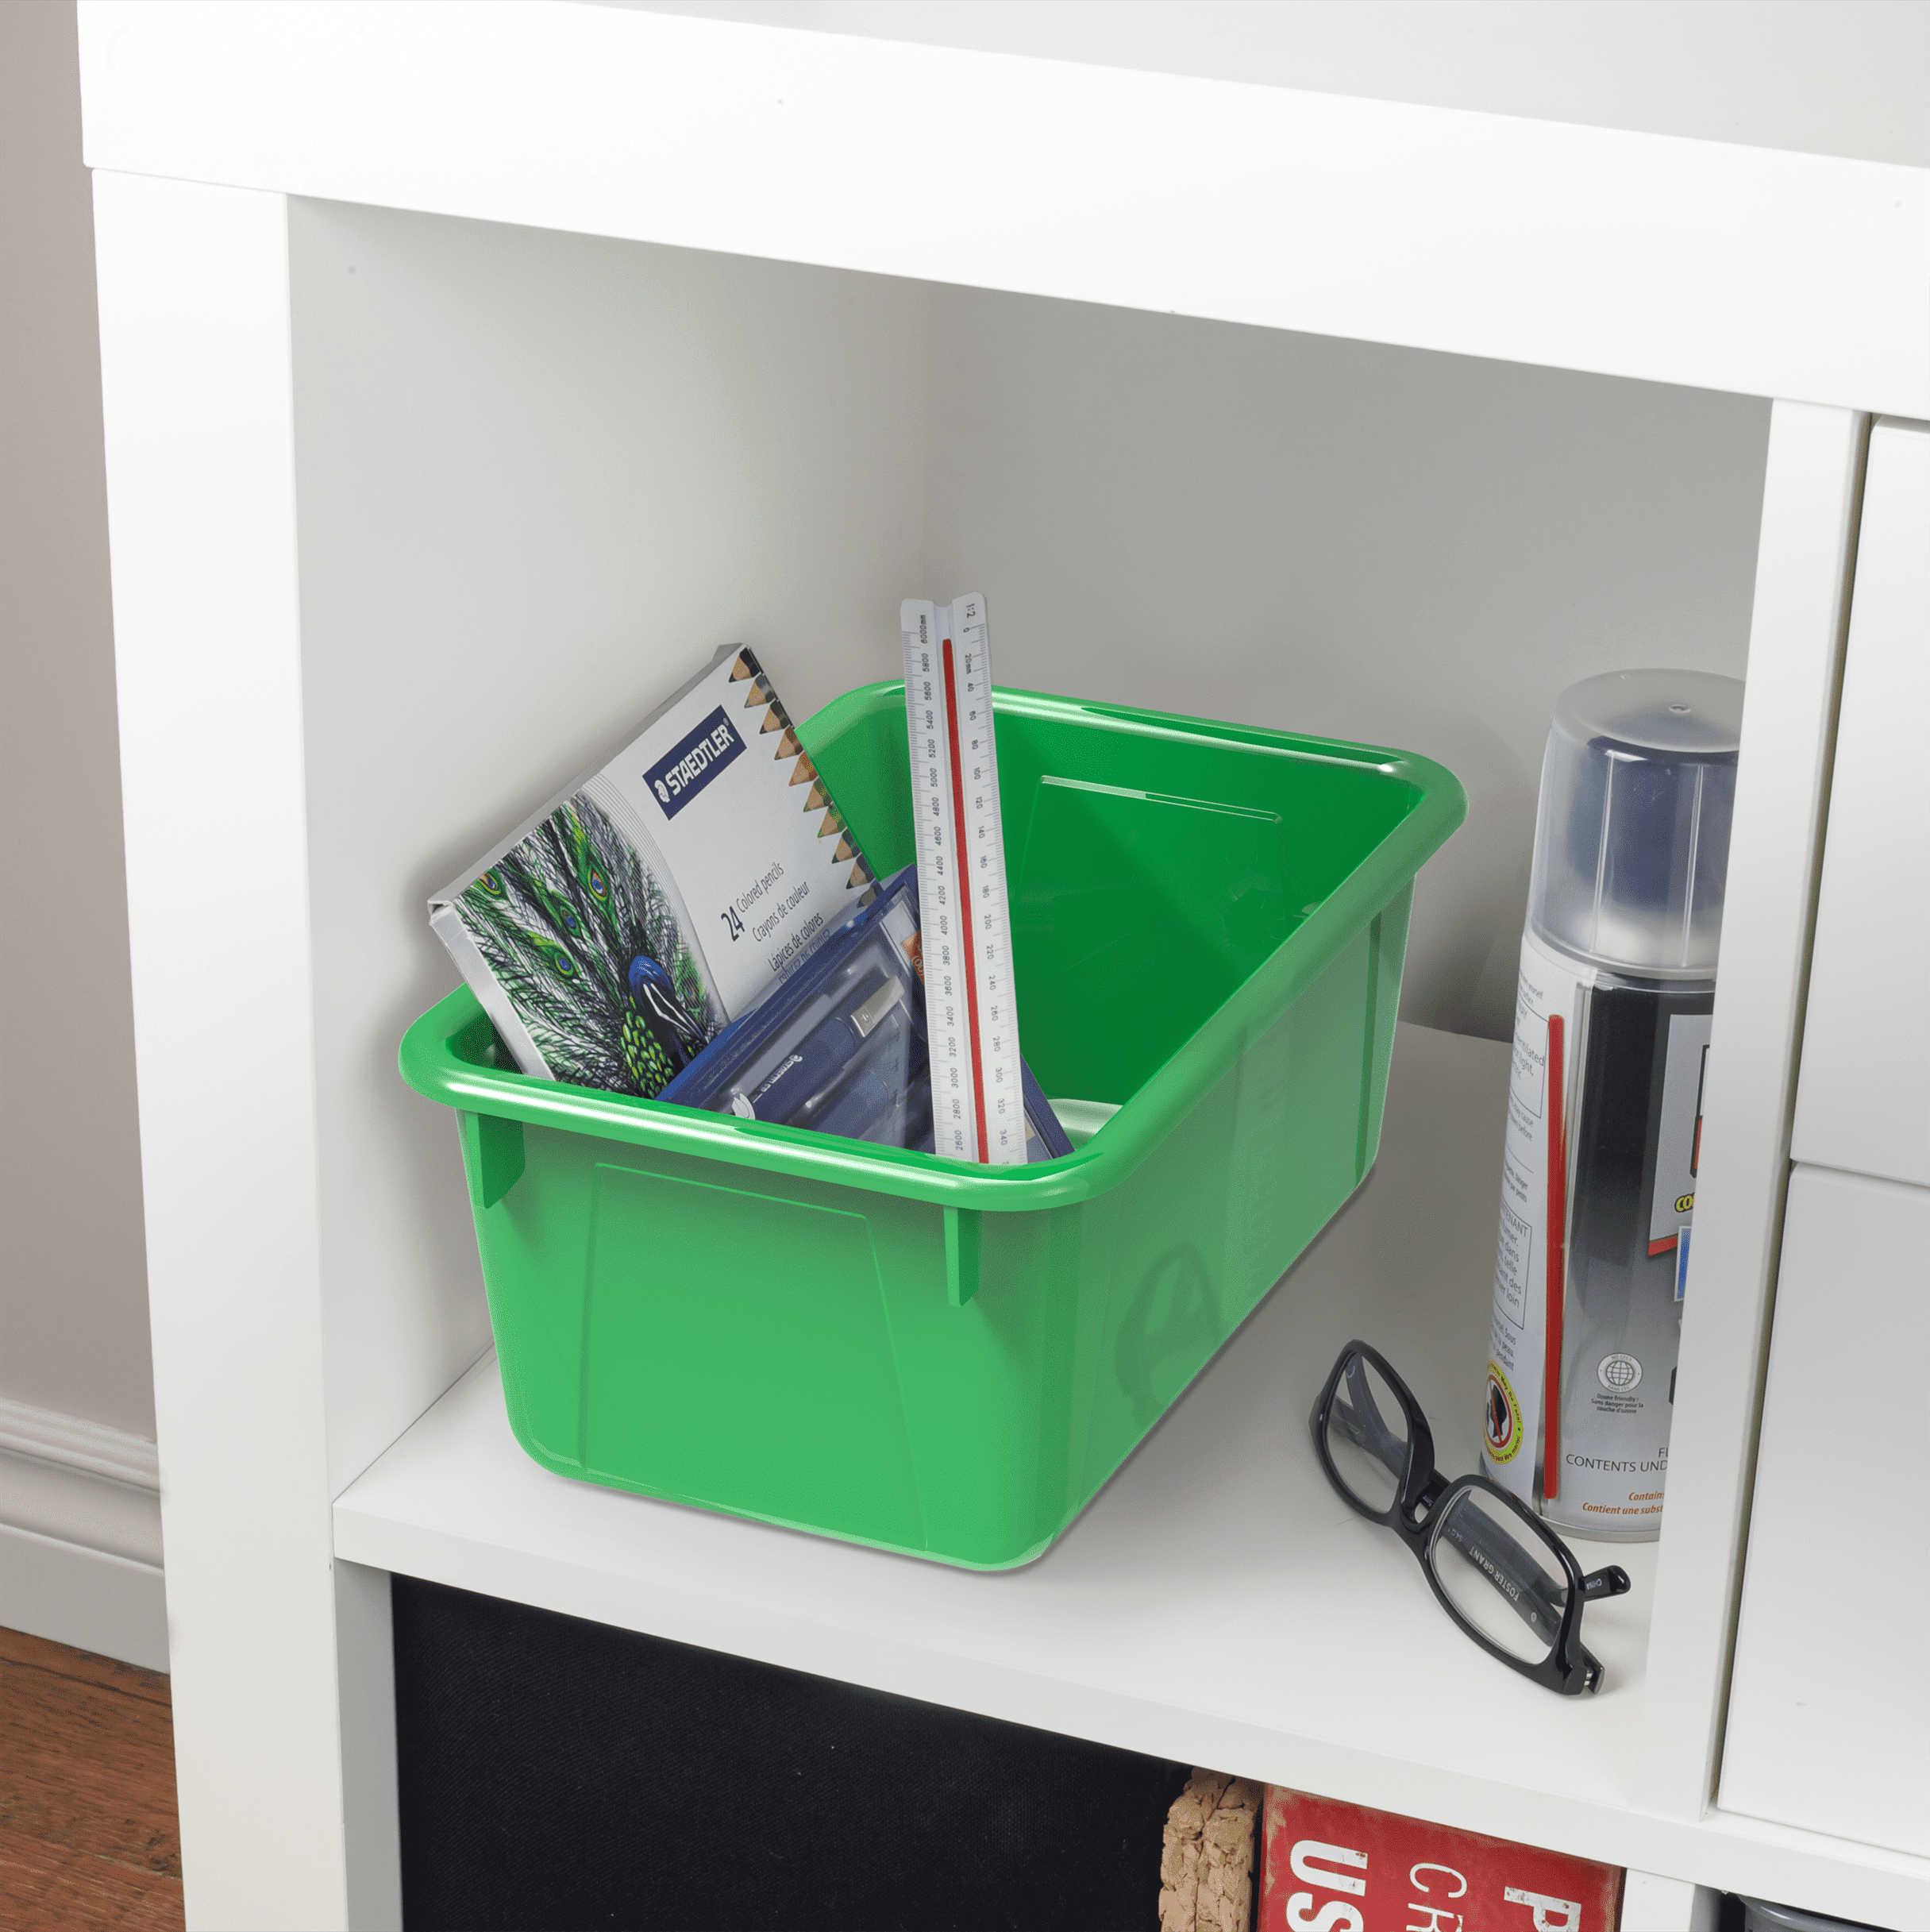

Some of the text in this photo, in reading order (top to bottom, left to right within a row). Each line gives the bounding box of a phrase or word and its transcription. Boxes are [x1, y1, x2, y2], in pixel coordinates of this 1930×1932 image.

[965, 604, 976, 619] 1:2
[967, 682, 974, 692] 40
[969, 711, 976, 720] 60
[972, 740, 978, 750] 80
[665, 723, 734, 796] STAEDTLER
[720, 862, 784, 943] 24 Colored pencils
[752, 881, 810, 943] Crayons de couleur
[767, 942, 795, 972] Lápices
[791, 932, 803, 949] de
[800, 912, 824, 940] colores
[942, 946, 950, 966] 3800
[946, 1006, 954, 1026] 3400
[948, 1037, 957, 1057] 3200
[952, 1099, 961, 1119] 2800
[1675, 1193, 1694, 1212] CO
[1504, 1242, 1520, 1263] dans
[1508, 1278, 1522, 1294] des
[1506, 1289, 1520, 1308] loin
[1604, 1400, 1624, 1409] danger
[1566, 1453, 1636, 1472] CONTENTS
[1628, 1490, 1664, 1501] Contain
[1582, 1502, 1621, 1514] Contient
[1468, 1545, 1521, 1602] FOSTER GRANT
[1585, 1578, 1603, 1591] CHINA
[1286, 1840, 1368, 1932] US
